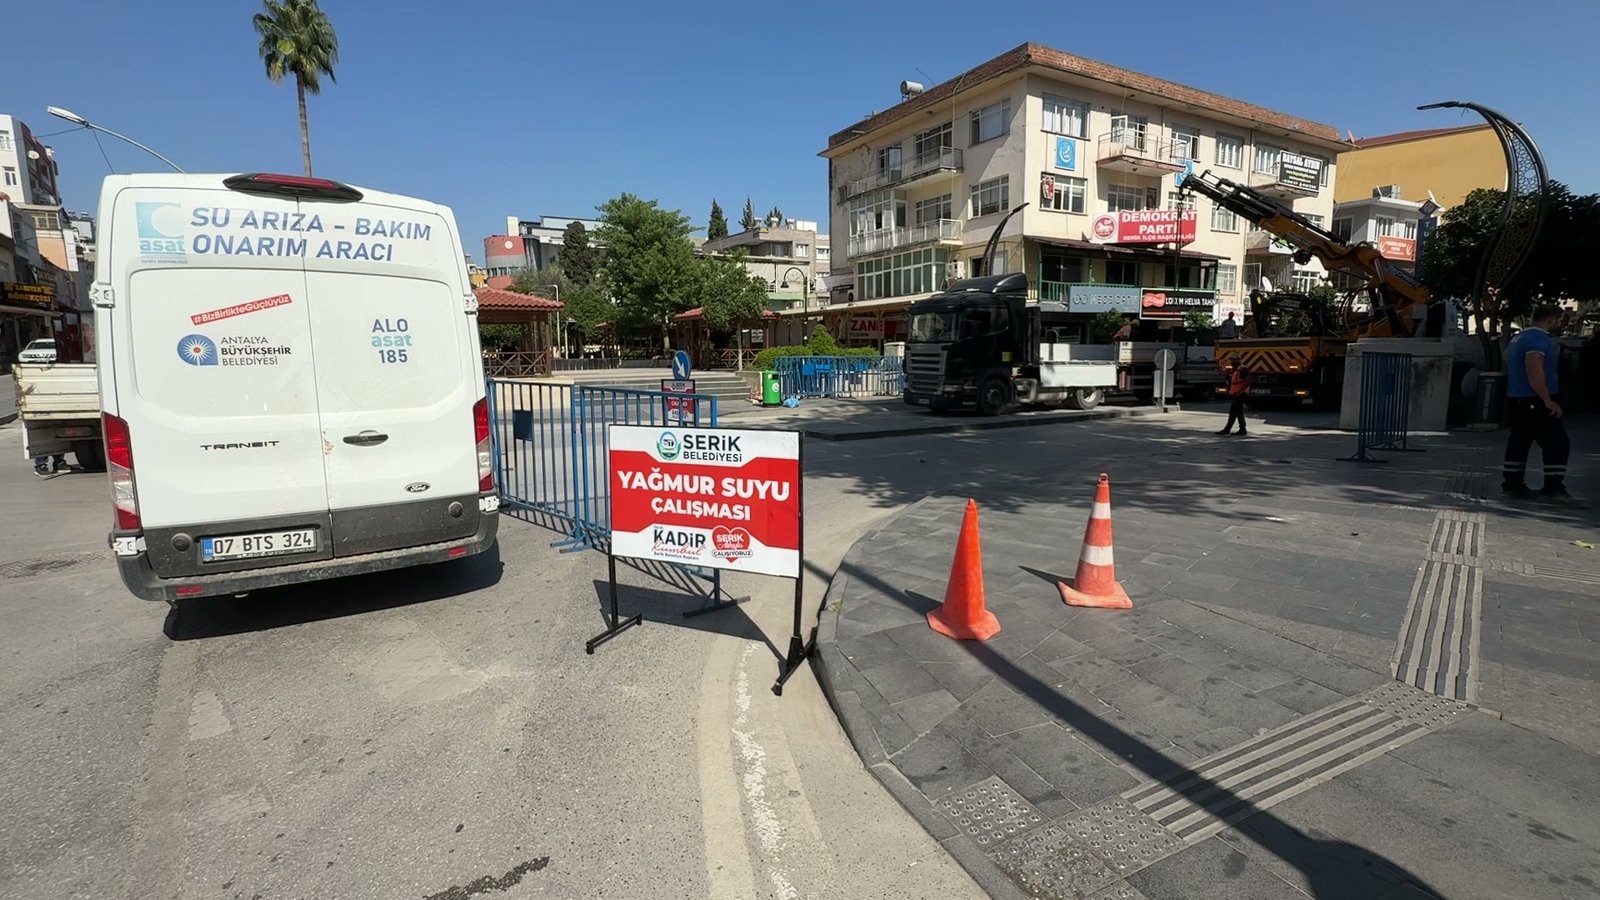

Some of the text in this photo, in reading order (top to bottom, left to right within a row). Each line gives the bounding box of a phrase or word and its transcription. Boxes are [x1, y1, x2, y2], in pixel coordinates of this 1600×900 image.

[1122, 211, 1197, 223] DEMOKRAT
[190, 207, 231, 228] SU
[240, 209, 324, 233] ARIZA
[354, 217, 431, 241] BAKIM
[1139, 222, 1178, 234] PARTİ
[139, 239, 186, 252] asat
[192, 234, 393, 262] ONARIM ARACI
[372, 318, 409, 333] ALO
[221, 336, 269, 345] ANTALYA
[371, 334, 412, 347] asat
[221, 345, 292, 357] BÜYÜKŞEHİR
[378, 349, 408, 364] 185
[222, 356, 279, 367] BELEDİYESİ
[200, 440, 280, 451] TRANSIT
[616, 466, 790, 501] YAĞMUR SUYU
[651, 497, 751, 521] ÇALIŞMASI
[214, 538, 234, 554] 07
[242, 535, 274, 552] BTS
[282, 532, 312, 548] 324
